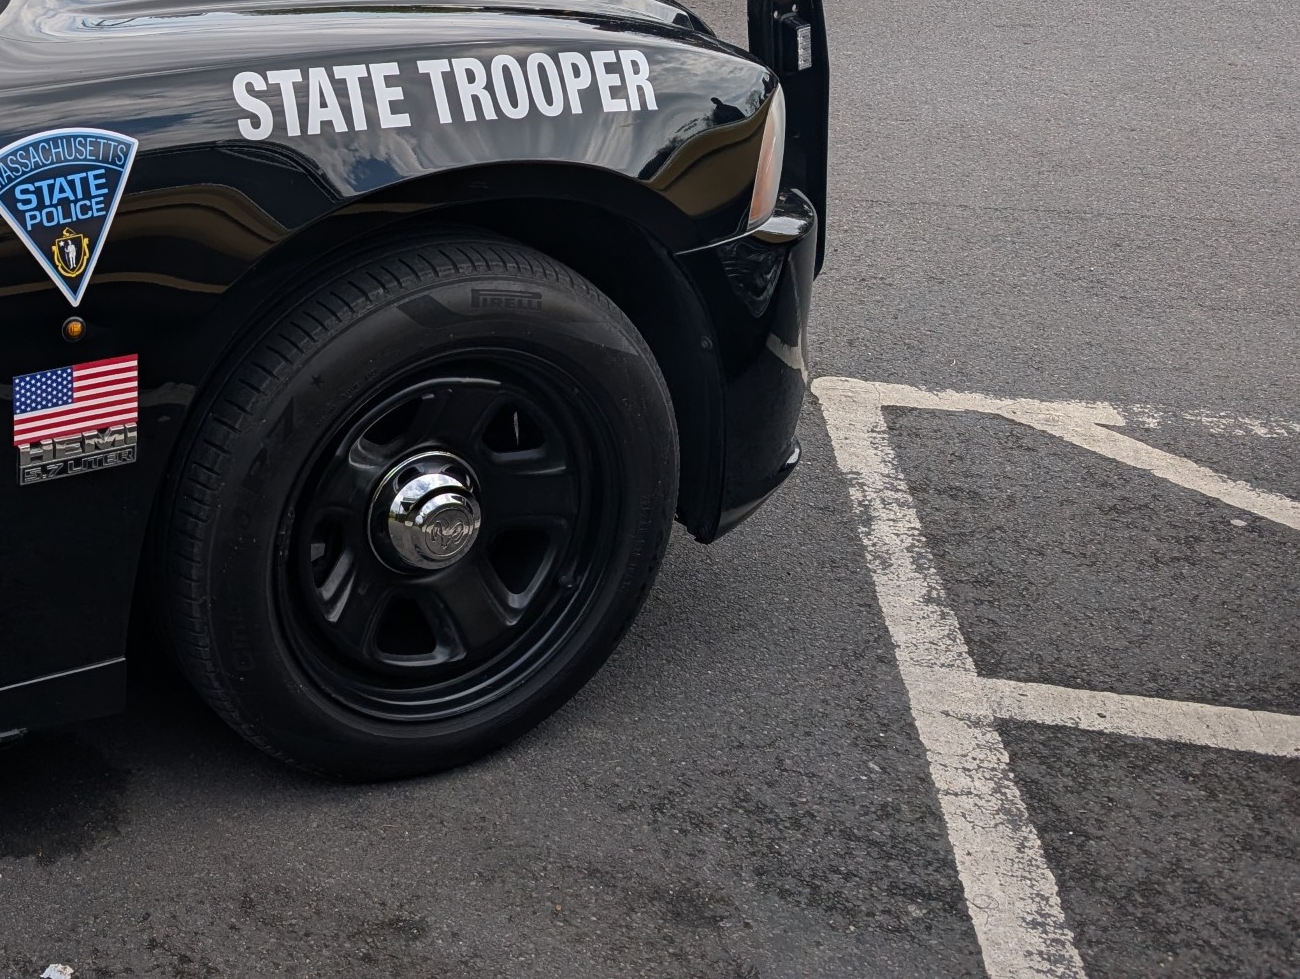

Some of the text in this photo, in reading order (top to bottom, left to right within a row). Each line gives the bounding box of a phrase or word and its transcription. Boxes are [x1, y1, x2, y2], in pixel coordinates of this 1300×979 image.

[232, 49, 658, 141] STATE TROOPER
[14, 168, 109, 211] STATE
[25, 196, 107, 231] POLICE
[470, 288, 543, 311] PIRELLI
[18, 421, 138, 467] HEMI
[24, 448, 134, 483] 5.7 LITER
